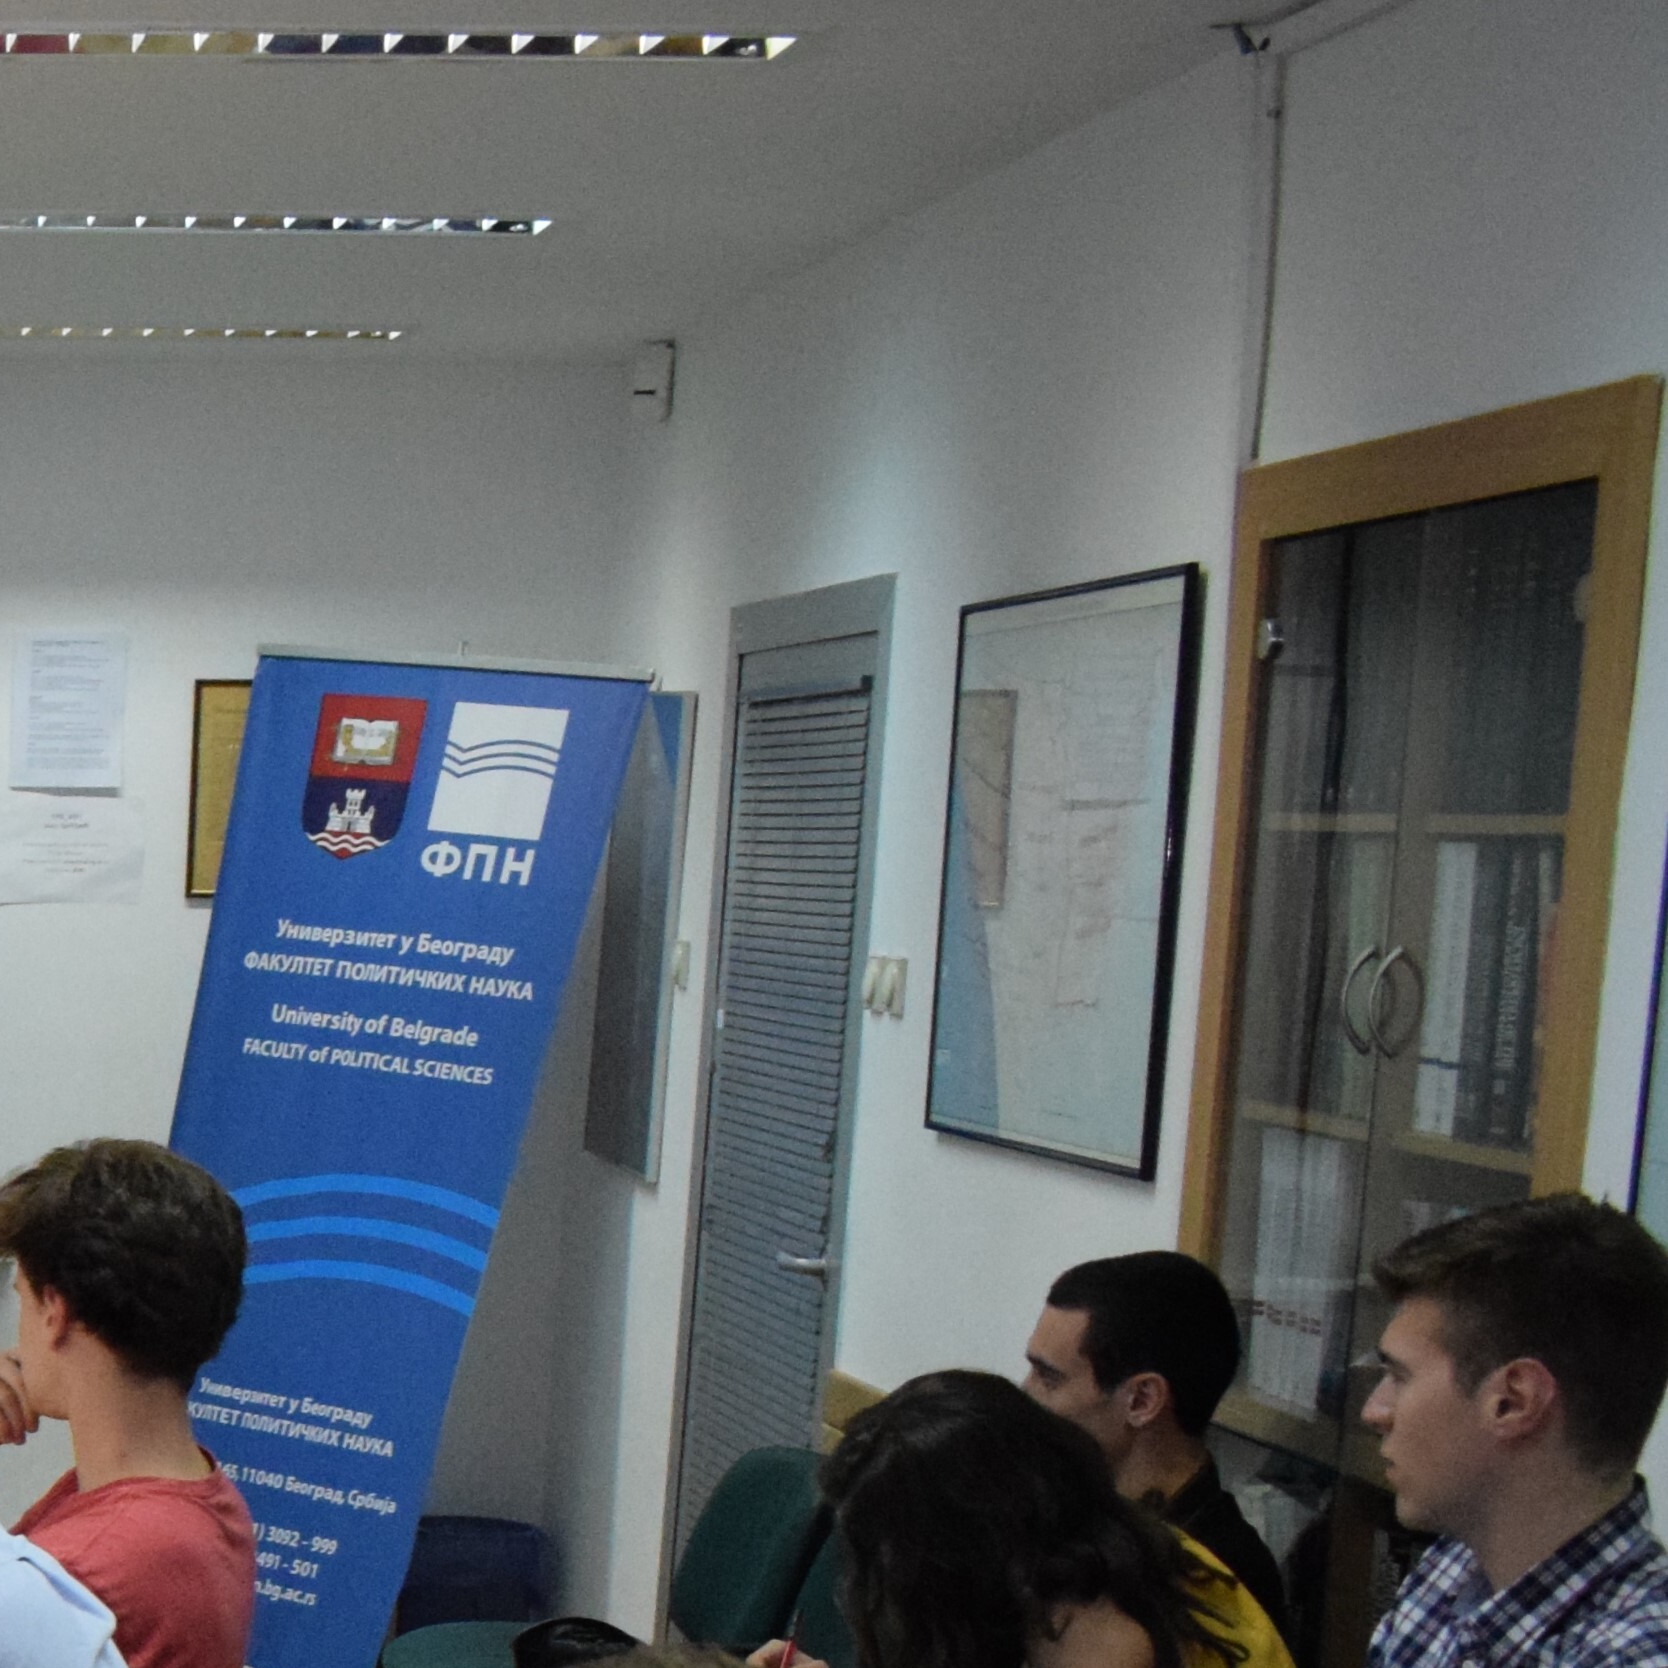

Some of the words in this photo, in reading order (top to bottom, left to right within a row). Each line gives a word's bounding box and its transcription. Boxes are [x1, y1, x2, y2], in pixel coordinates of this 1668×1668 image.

[420, 840, 536, 886] ФПН
[275, 918, 396, 949] Универзитет
[398, 935, 414, 955] у
[416, 933, 516, 967] Београду
[244, 951, 334, 977] ФАКУЛТЕТ
[335, 961, 467, 993] ПОЛИТИЧКИХ
[468, 976, 534, 1001] НАУКА
[271, 1002, 363, 1037] University
[364, 1014, 388, 1035] of
[389, 1017, 479, 1047] Belgrade
[242, 1038, 307, 1061] FACULTY
[308, 1047, 329, 1063] of
[330, 1049, 415, 1075] POLITICAL
[412, 1059, 494, 1085] SCIENCES
[199, 1377, 287, 1406] Универзитет
[288, 1398, 300, 1414] у
[301, 1398, 373, 1429] Београду
[188, 1401, 241, 1427] КУЛТЕТ
[241, 1412, 339, 1447] ПОЛИТИЧКИХ
[343, 1433, 394, 1458] НАУКА
[242, 1467, 282, 1489] 11040
[347, 1490, 397, 1515] Србија
[266, 1526, 300, 1547] 3092
[311, 1536, 338, 1555] 999
[256, 1551, 281, 1569] 491
[290, 1560, 319, 1578] 501
